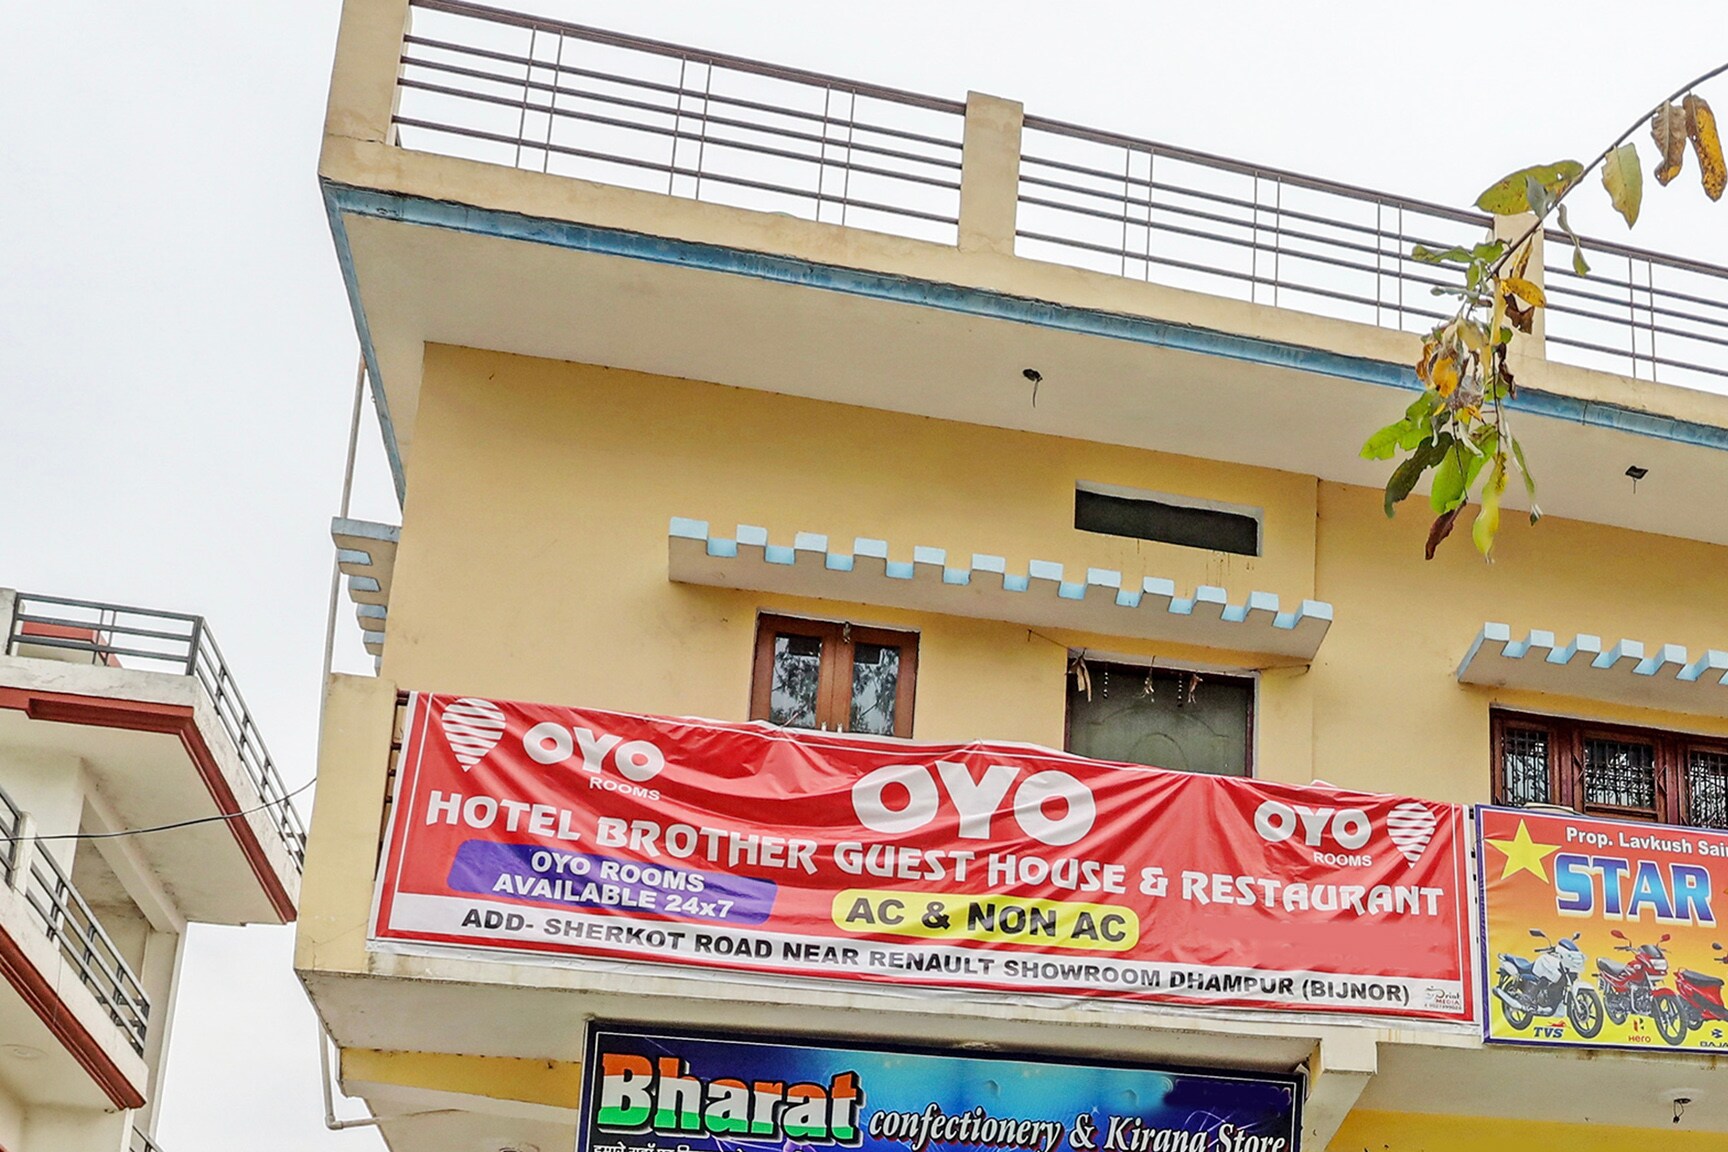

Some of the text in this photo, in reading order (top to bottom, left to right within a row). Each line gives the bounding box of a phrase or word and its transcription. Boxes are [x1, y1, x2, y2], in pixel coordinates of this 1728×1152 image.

[523, 722, 665, 782] OYO
[589, 776, 660, 800] ROOMS
[852, 760, 1096, 846] OYO
[1254, 800, 1372, 849] OYO
[1566, 827, 1612, 846] Prop.
[1619, 833, 1692, 854] Lavkush
[426, 790, 1443, 916] HOTEL BROTHER GUEST HOUSE & RESTAURANT
[531, 851, 704, 892] OYO ROOMS
[1313, 852, 1372, 867] ROOMS
[493, 873, 734, 919] AVAILABLE 24x7
[1554, 853, 1717, 927] STAR
[846, 898, 1126, 942] AC & NON AC
[462, 908, 1409, 1006] ADD- SHERKOT ROAD NEAR RENAULT SHOWROOM DHAMPUR (BIJNOR)
[1534, 1027, 1563, 1038] TVS
[598, 1053, 859, 1140] Bharat
[1070, 1108, 1097, 1149] &
